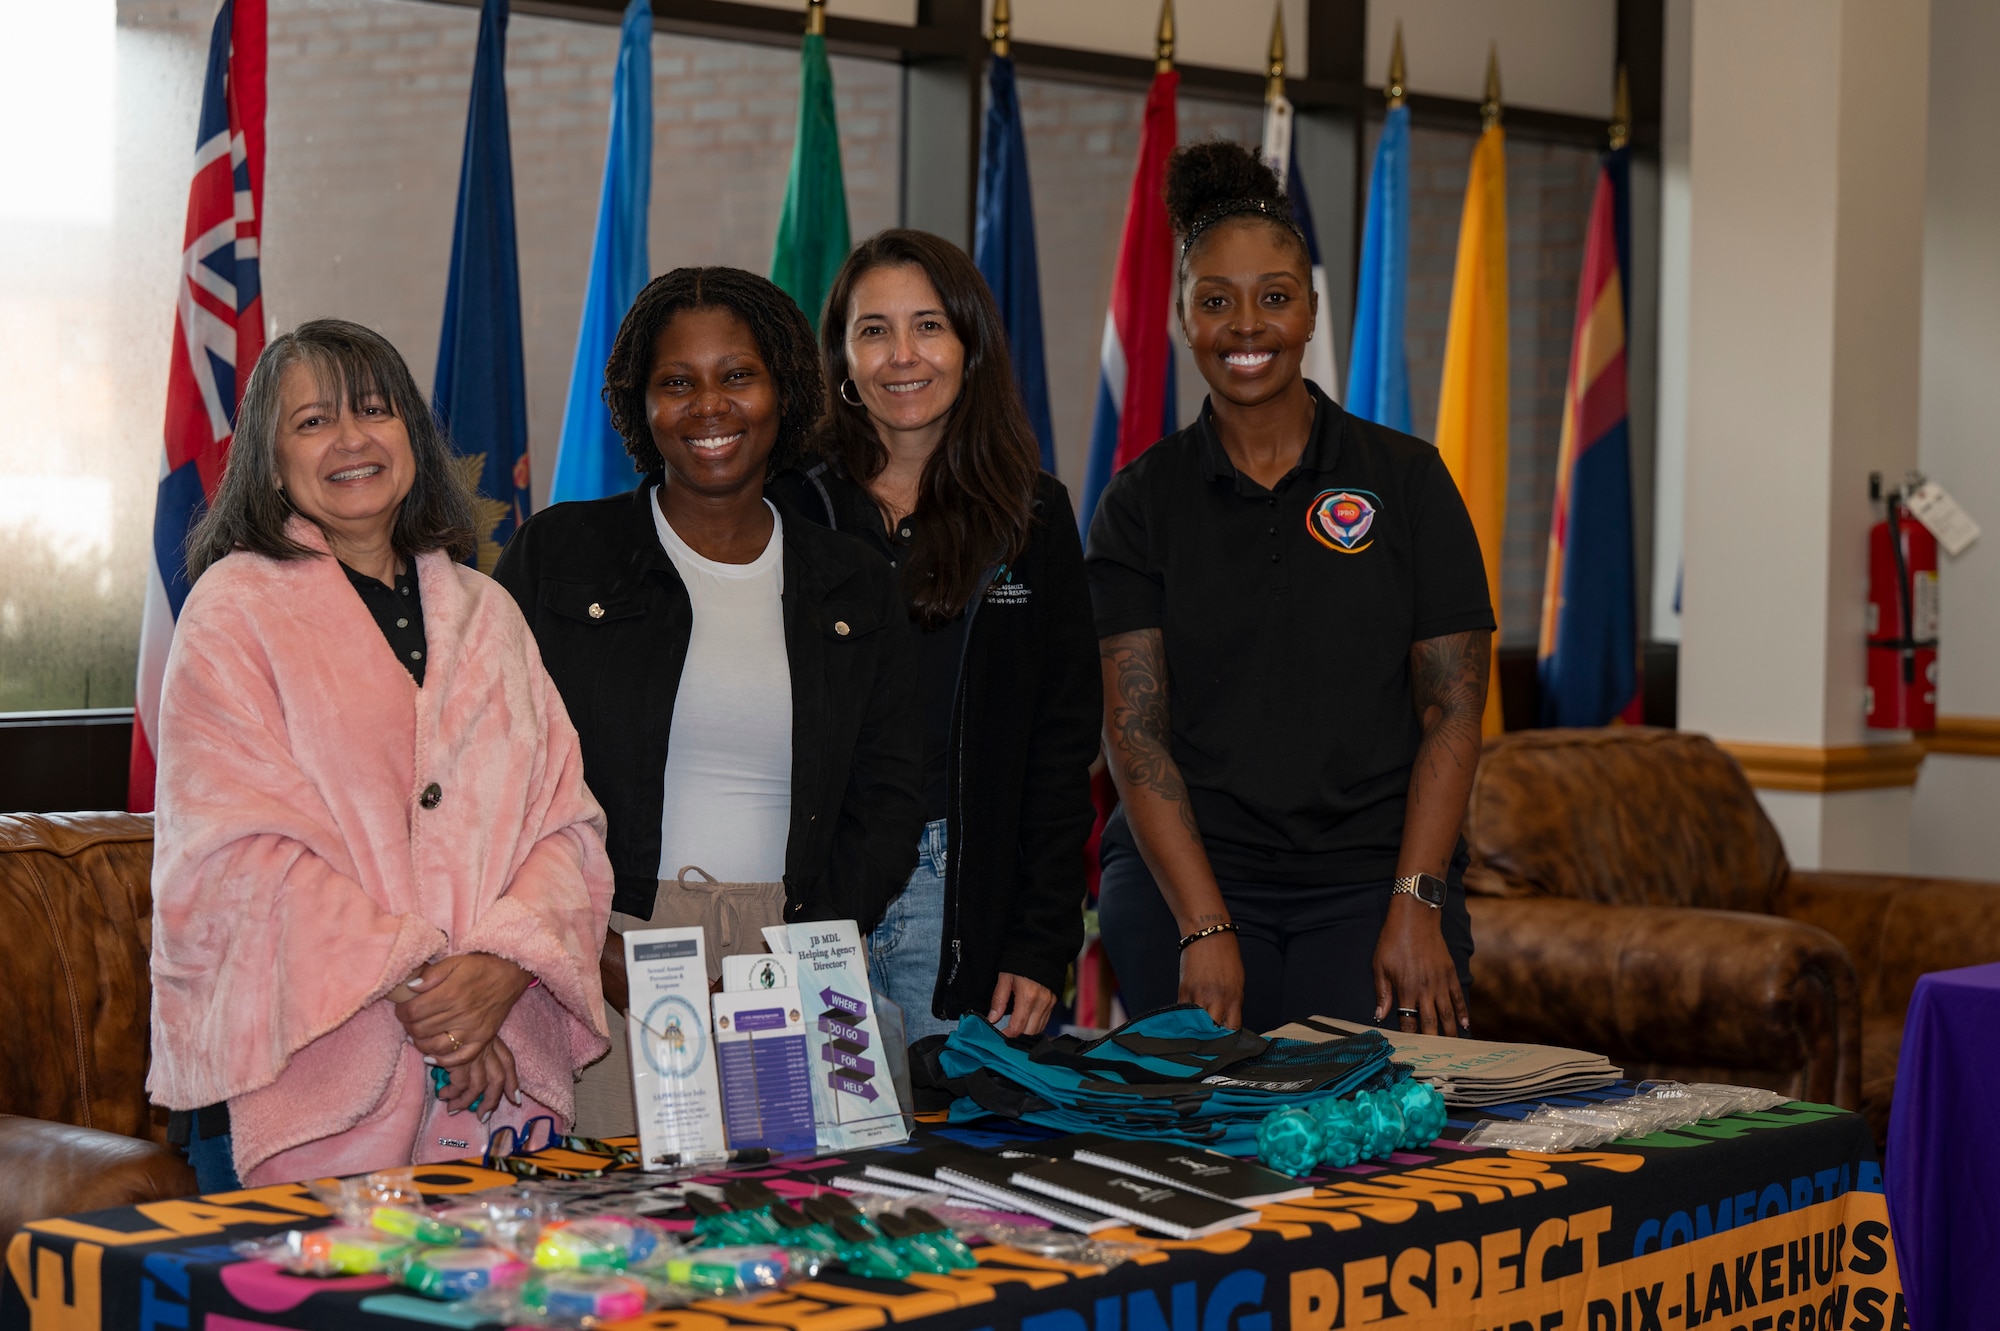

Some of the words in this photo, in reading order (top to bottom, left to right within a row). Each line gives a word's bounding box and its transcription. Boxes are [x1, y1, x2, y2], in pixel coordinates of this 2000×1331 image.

[810, 936, 820, 948] JB
[821, 933, 841, 944] MDL
[798, 949, 829, 960] Helping
[831, 946, 856, 957] Agency
[813, 960, 847, 971] Directory
[831, 994, 858, 1012] WHERE
[829, 1022, 841, 1034] DO
[842, 1028, 845, 1036] I
[846, 1030, 858, 1040] GO
[841, 1054, 857, 1067] FOR
[843, 1081, 864, 1094] HELP
[1290, 1205, 1613, 1331] RESPECT
[1588, 1220, 1890, 1331] DIX-LAKEHURS
